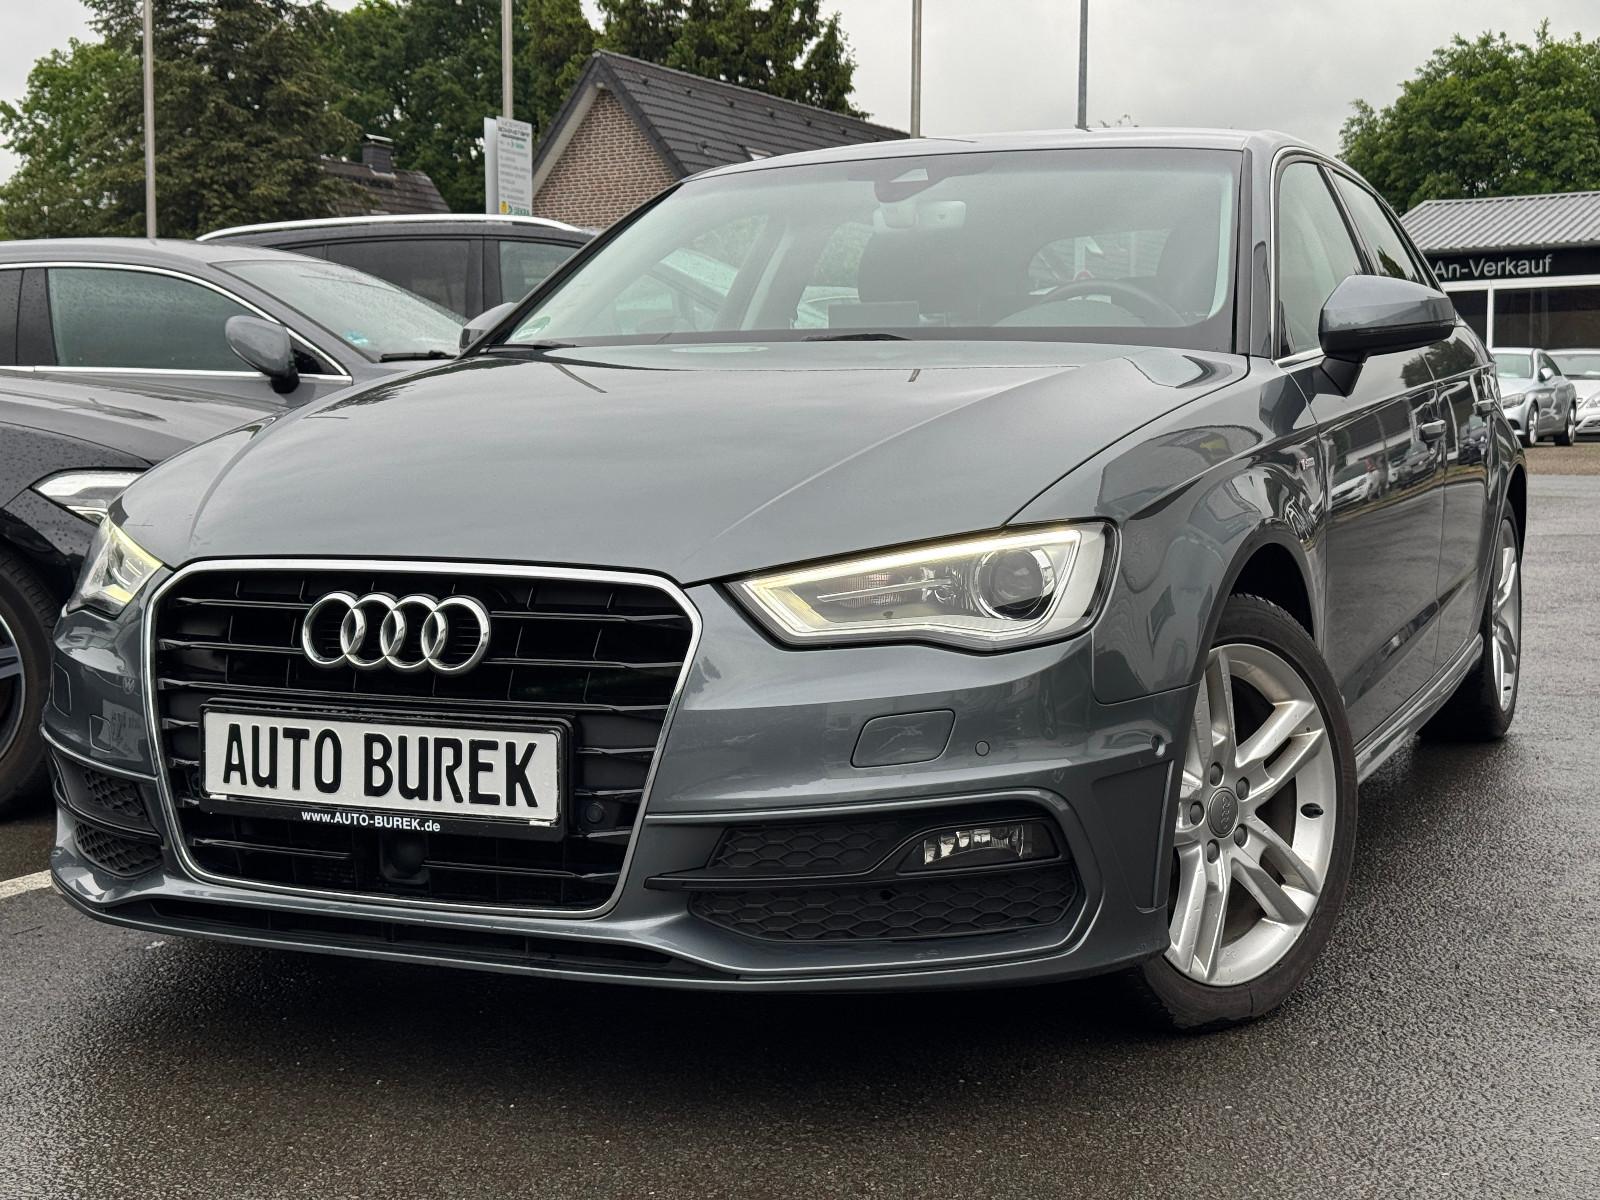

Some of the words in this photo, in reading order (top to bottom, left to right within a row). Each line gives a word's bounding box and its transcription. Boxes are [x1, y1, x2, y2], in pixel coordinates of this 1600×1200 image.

[1434, 254, 1552, 279] An-Verkauf
[223, 723, 342, 793] AUTO
[364, 733, 538, 807] BUREK
[301, 811, 441, 832] www.AUTO-BUREK.de
